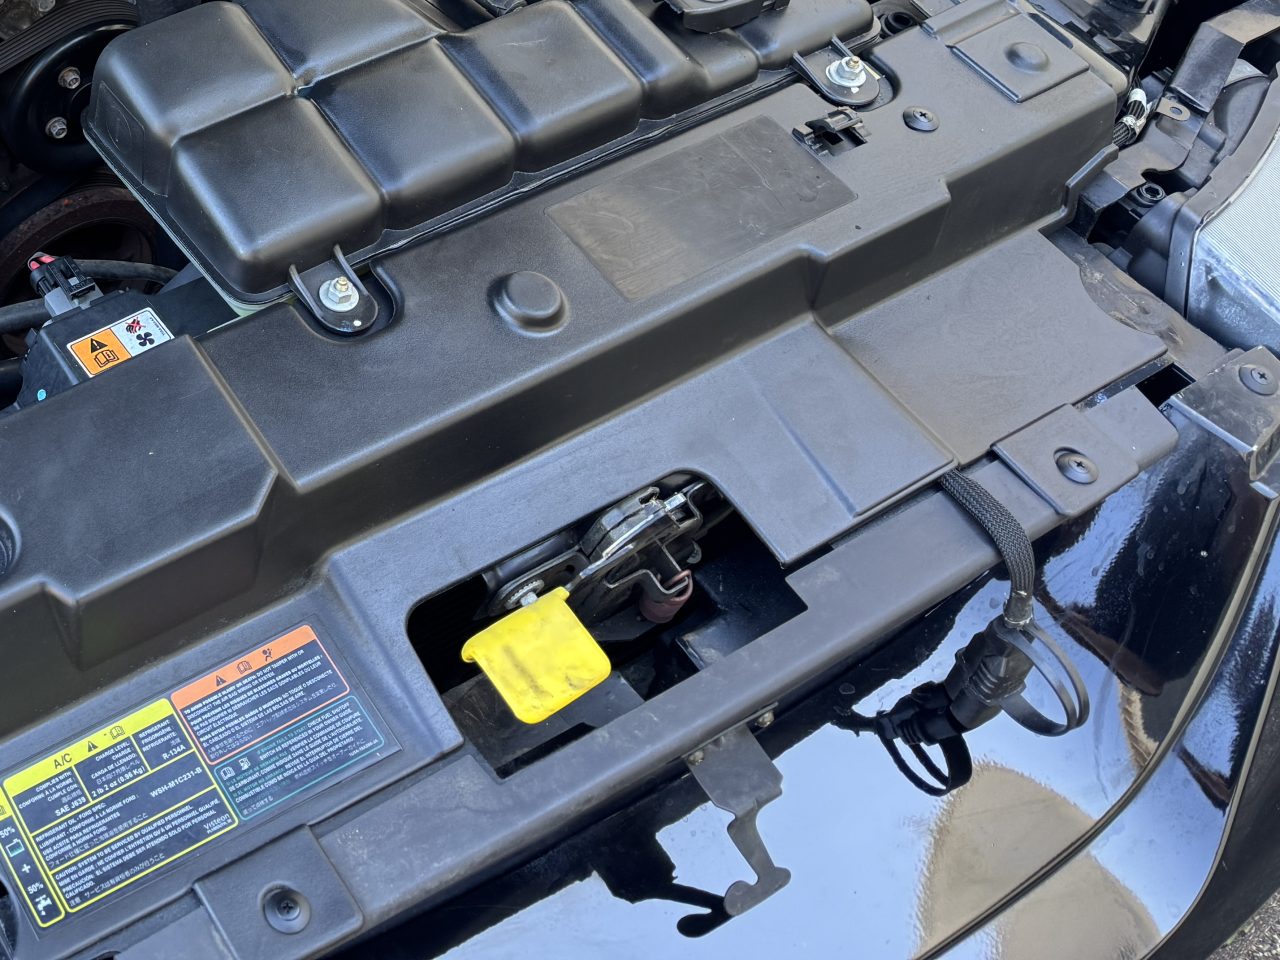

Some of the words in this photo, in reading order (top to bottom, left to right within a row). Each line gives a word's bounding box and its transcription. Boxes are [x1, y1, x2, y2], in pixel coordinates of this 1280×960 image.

[271, 657, 287, 668] TAMPER
[287, 652, 297, 660] WITH
[186, 703, 213, 720] DISCONNECT
[227, 690, 238, 698] BAG
[196, 725, 213, 736] CIRCUIT
[54, 752, 73, 770] A/C
[94, 748, 115, 761] CHARGE
[111, 747, 131, 760] CHARGE
[162, 744, 186, 759] R-134A
[90, 767, 108, 779] CARGA
[96, 786, 104, 794] lb
[108, 780, 117, 788] oz
[116, 771, 133, 783] (0.96
[132, 765, 145, 776] Kg)
[149, 766, 202, 797] WSH-M1C231-B
[17, 791, 45, 808] CONFORME
[55, 777, 73, 790] NORME
[35, 777, 59, 792] COMPLIES
[46, 788, 66, 801] CUMPLE
[54, 804, 70, 816] SAE
[69, 796, 86, 808] J639
[35, 822, 68, 842] REFRIGERANT
[67, 817, 76, 825] OIL
[78, 809, 92, 819] FORD
[38, 831, 66, 849] LUBRIFIANT
[68, 816, 95, 833] CONFORME
[105, 801, 122, 813] NORME
[122, 794, 136, 804] FORD
[203, 812, 230, 830] Visteon
[42, 846, 52, 855] USE
[52, 837, 69, 850] ACEITE
[69, 831, 82, 841] PARA
[82, 811, 120, 834] REFRIGERANTES
[77, 854, 97, 867] SYSTEM
[110, 834, 134, 850] SERVICED
[140, 818, 165, 834] QUALIFIED
[101, 858, 122, 872] SISTEMA
[122, 851, 135, 861] DEBE
[135, 846, 145, 854] SER
[145, 833, 168, 849] ATENDIDO
[168, 826, 181, 837] SOLO
[181, 821, 192, 829] POR
[191, 808, 216, 824] PERSONAL
[44, 843, 72, 860] CONFORME
[75, 832, 93, 844] NORMA
[58, 877, 70, 886] MISE
[77, 864, 94, 876] GARDE
[103, 848, 124, 862] CONFIER
[171, 809, 199, 826] PERSONNEL
[27, 880, 44, 894] 50%
